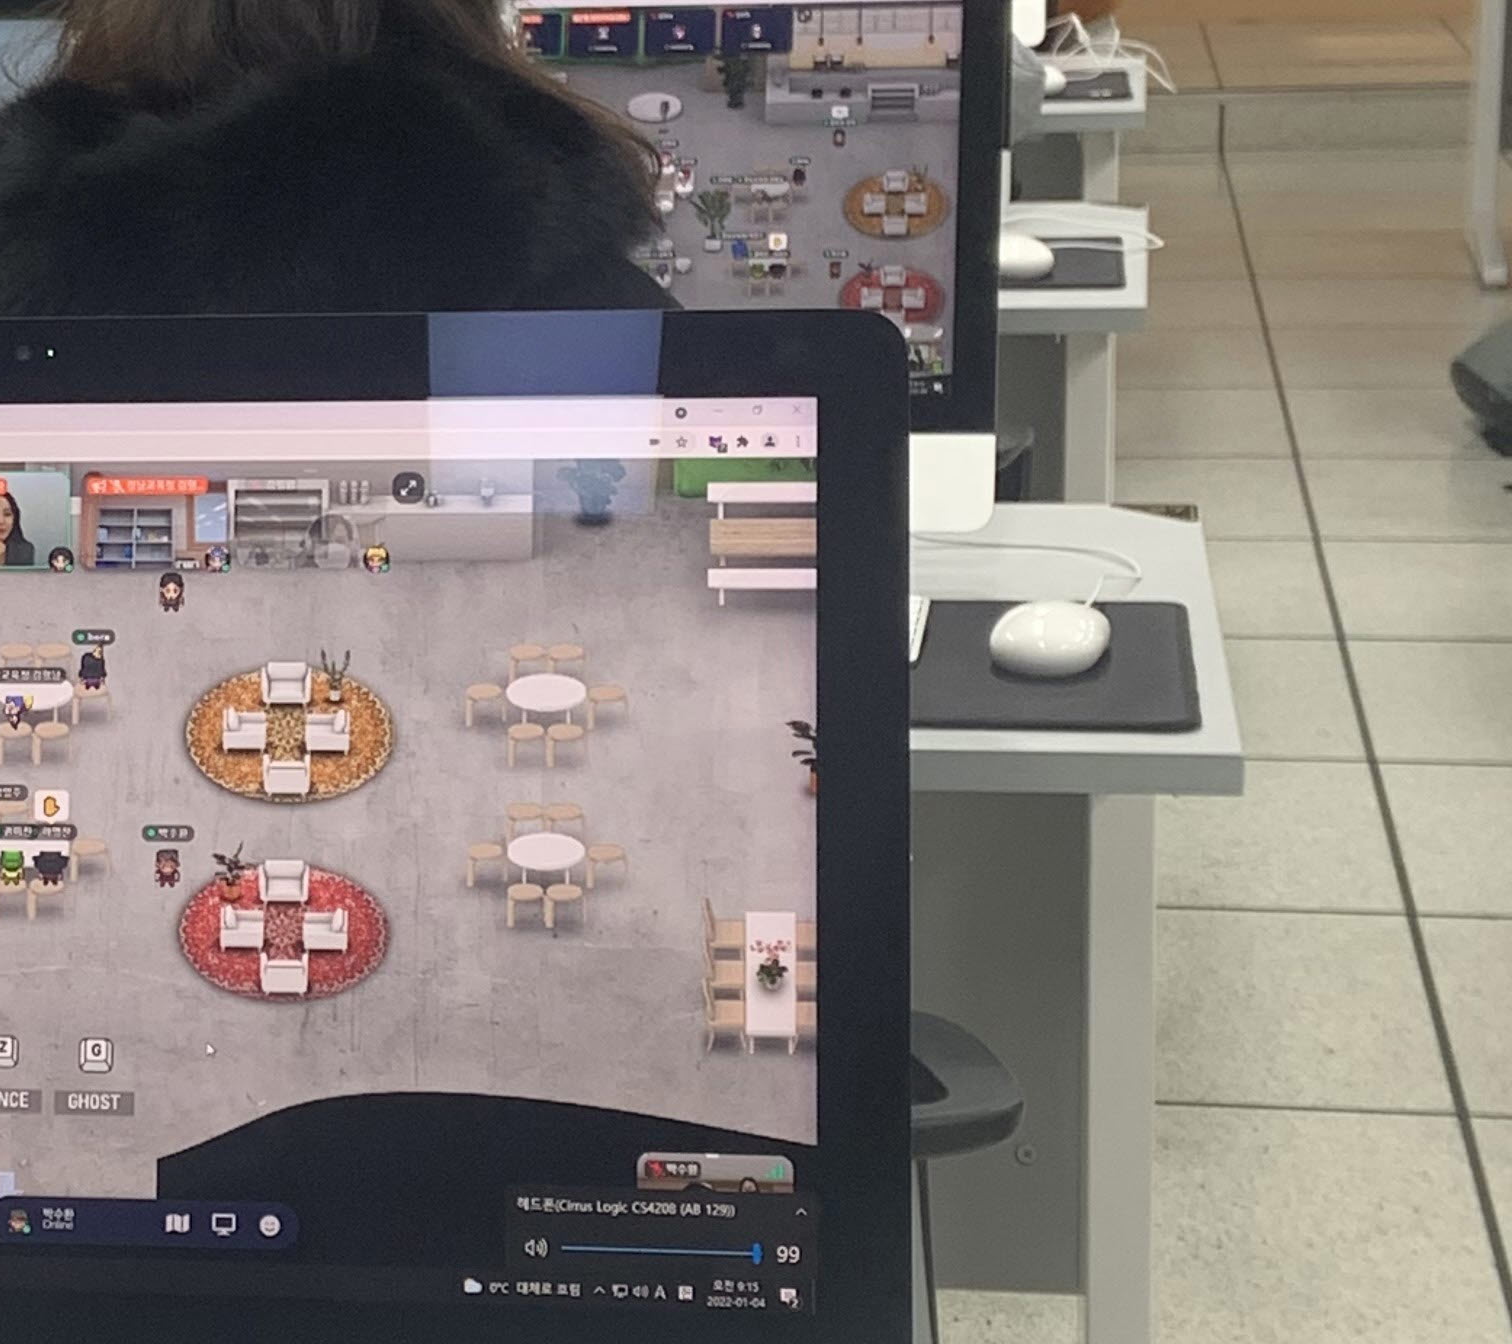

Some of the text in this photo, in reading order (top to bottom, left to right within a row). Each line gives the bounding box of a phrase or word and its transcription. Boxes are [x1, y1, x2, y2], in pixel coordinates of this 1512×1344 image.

[90, 1043, 102, 1057] G
[67, 1093, 121, 1112] GHOST
[595, 1200, 629, 1218] Logic
[631, 1202, 677, 1216] CS4208
[679, 1202, 702, 1217] (AB
[775, 1246, 801, 1264] 99
[516, 1281, 553, 1297] 대체로
[654, 1285, 667, 1300] A
[713, 1279, 734, 1293] 오전
[706, 1295, 767, 1309] 2022-01-04
